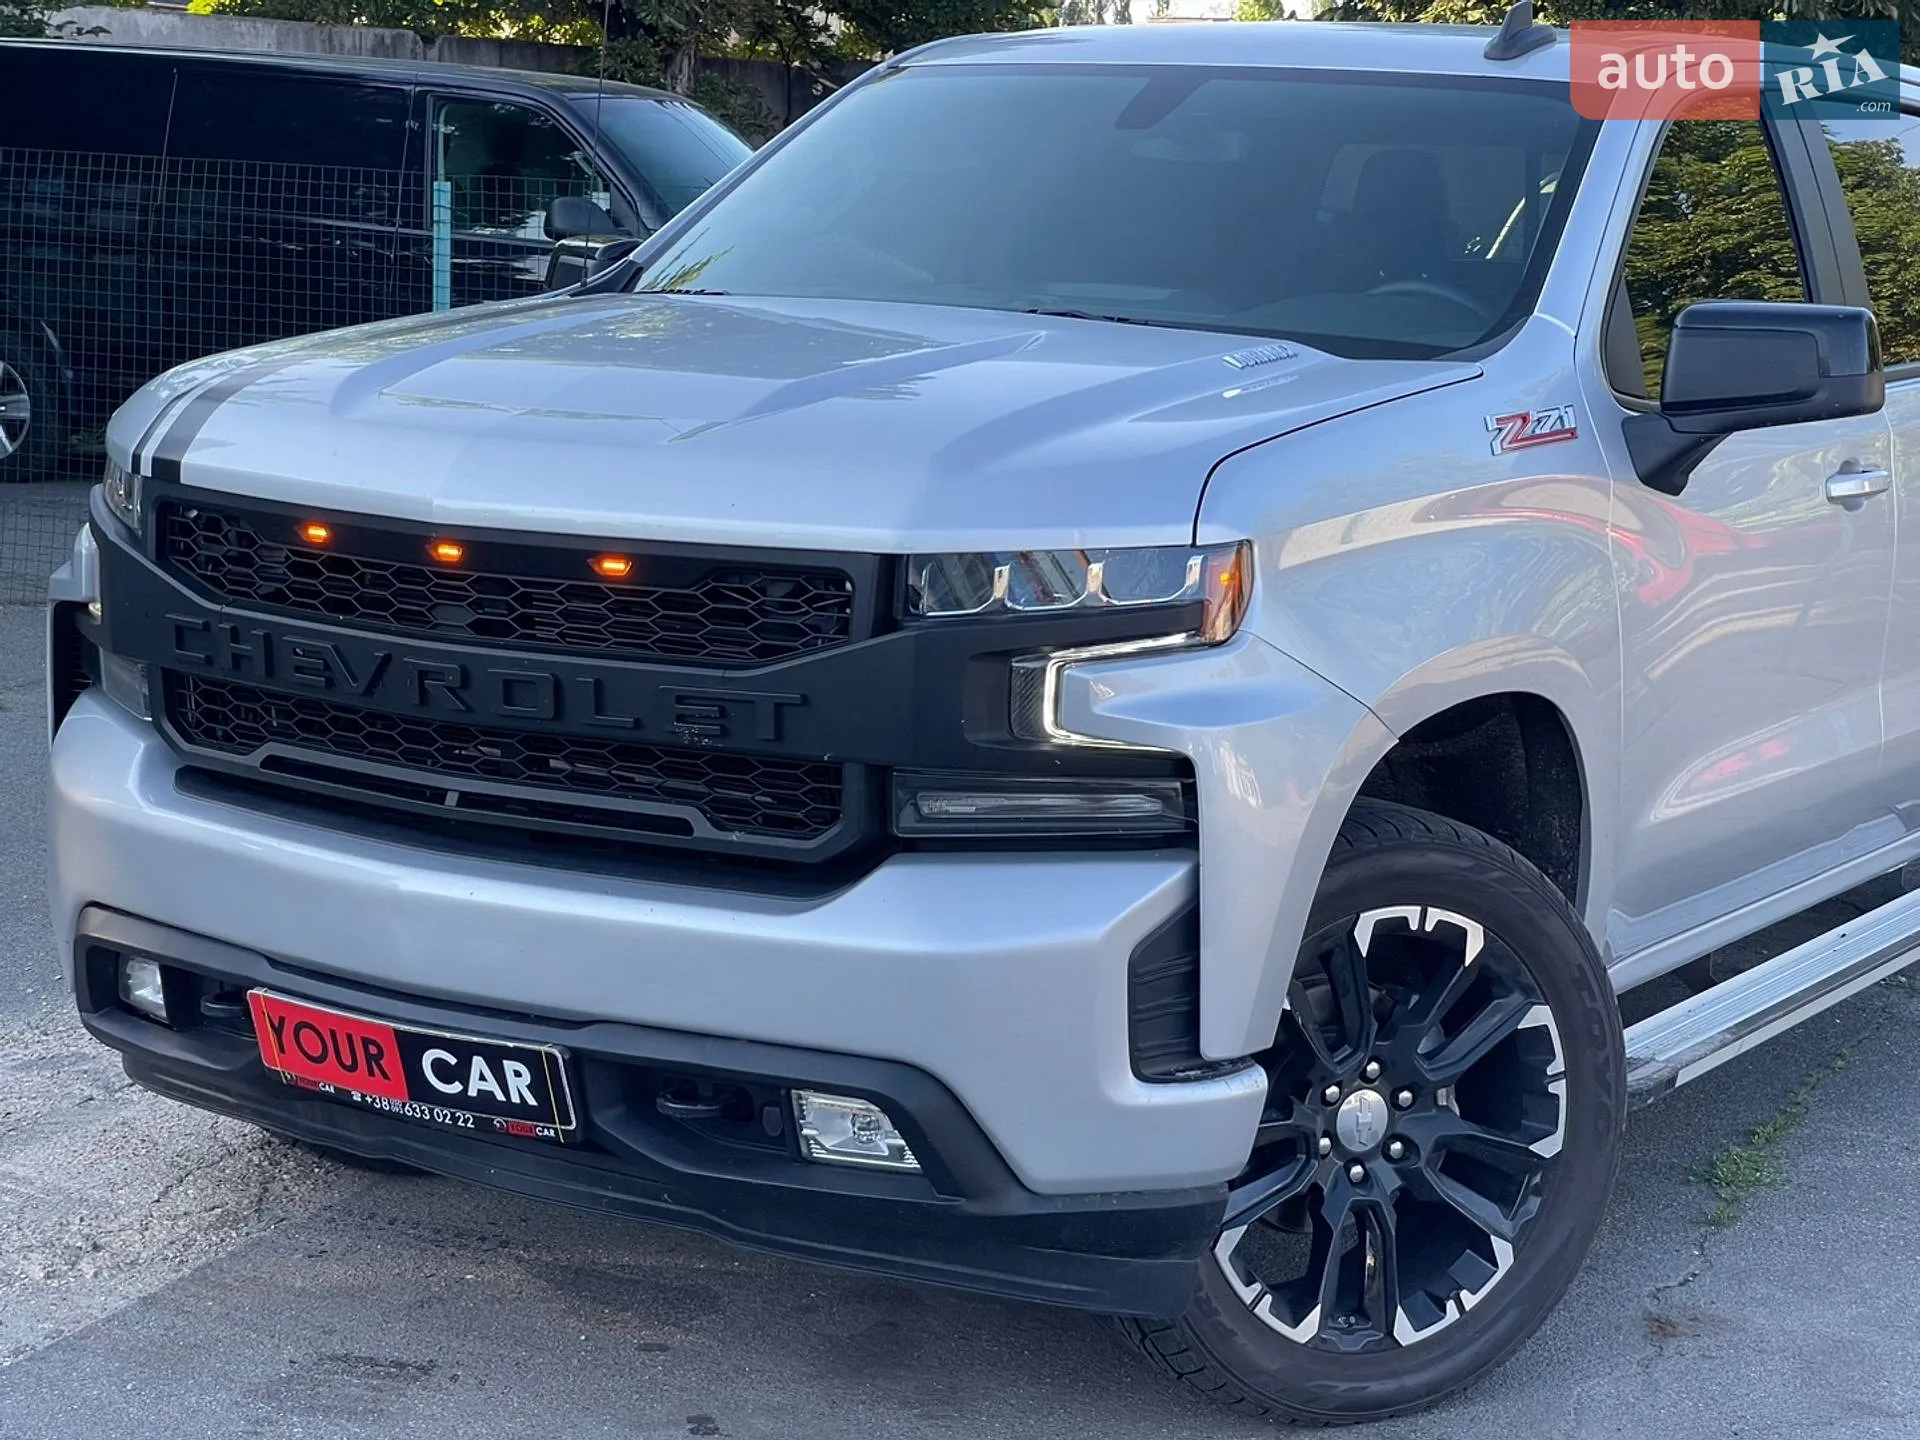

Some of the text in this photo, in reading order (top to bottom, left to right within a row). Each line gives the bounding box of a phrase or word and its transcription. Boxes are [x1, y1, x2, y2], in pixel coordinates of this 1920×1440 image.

[1483, 403, 1577, 456] Z71
[165, 613, 806, 742] CHEVROLET
[262, 1009, 538, 1106] YOUR CAR
[434, 1108, 452, 1124] 02
[455, 1113, 475, 1128] 22
[536, 1127, 556, 1137] CAR
